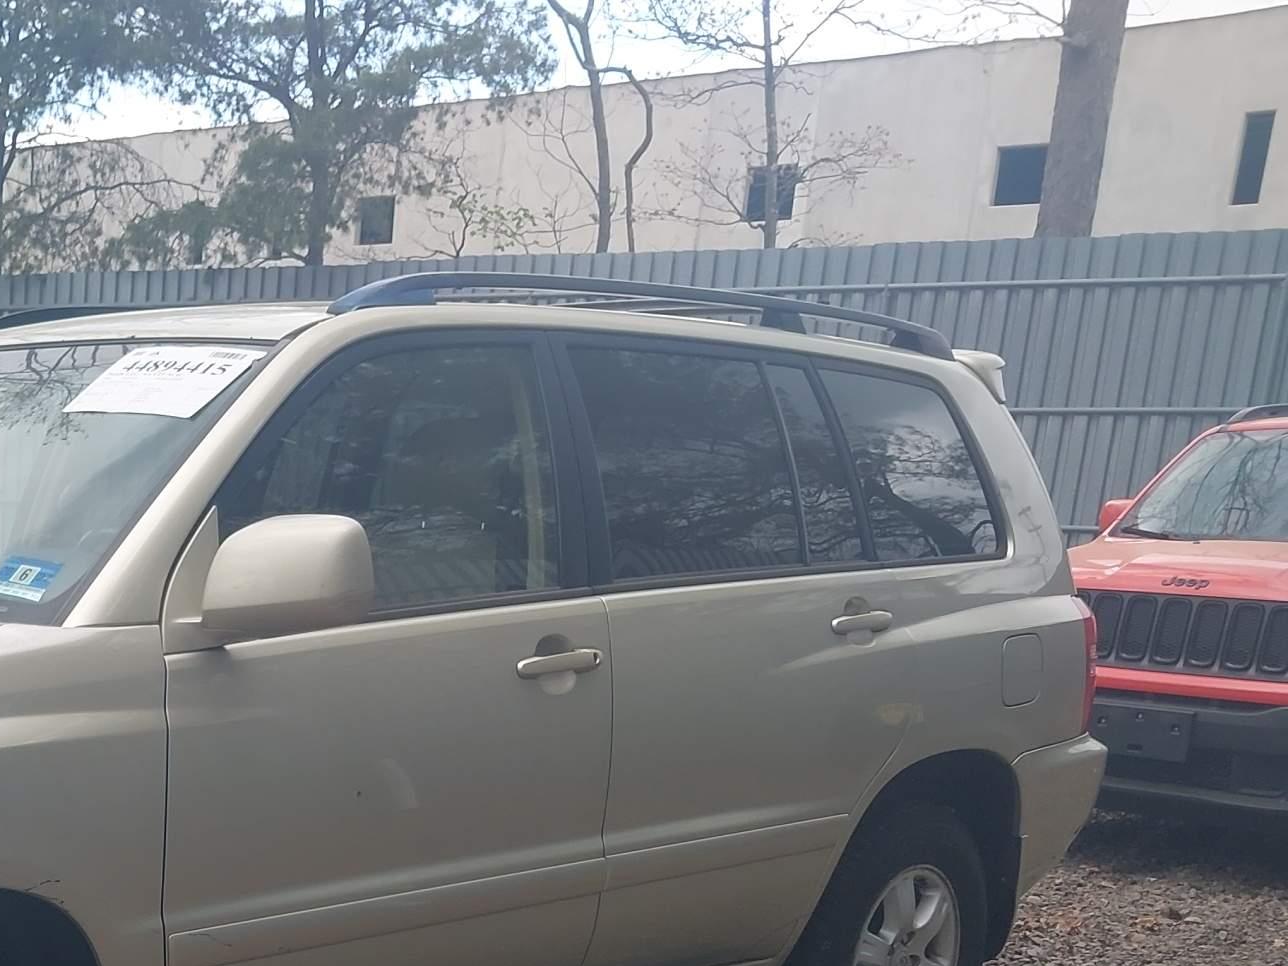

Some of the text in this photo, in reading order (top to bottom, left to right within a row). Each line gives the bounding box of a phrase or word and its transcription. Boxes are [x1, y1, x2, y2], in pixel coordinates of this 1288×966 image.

[122, 360, 232, 375] 44894415
[19, 568, 32, 581] 6
[1161, 575, 1210, 590] Jeep
